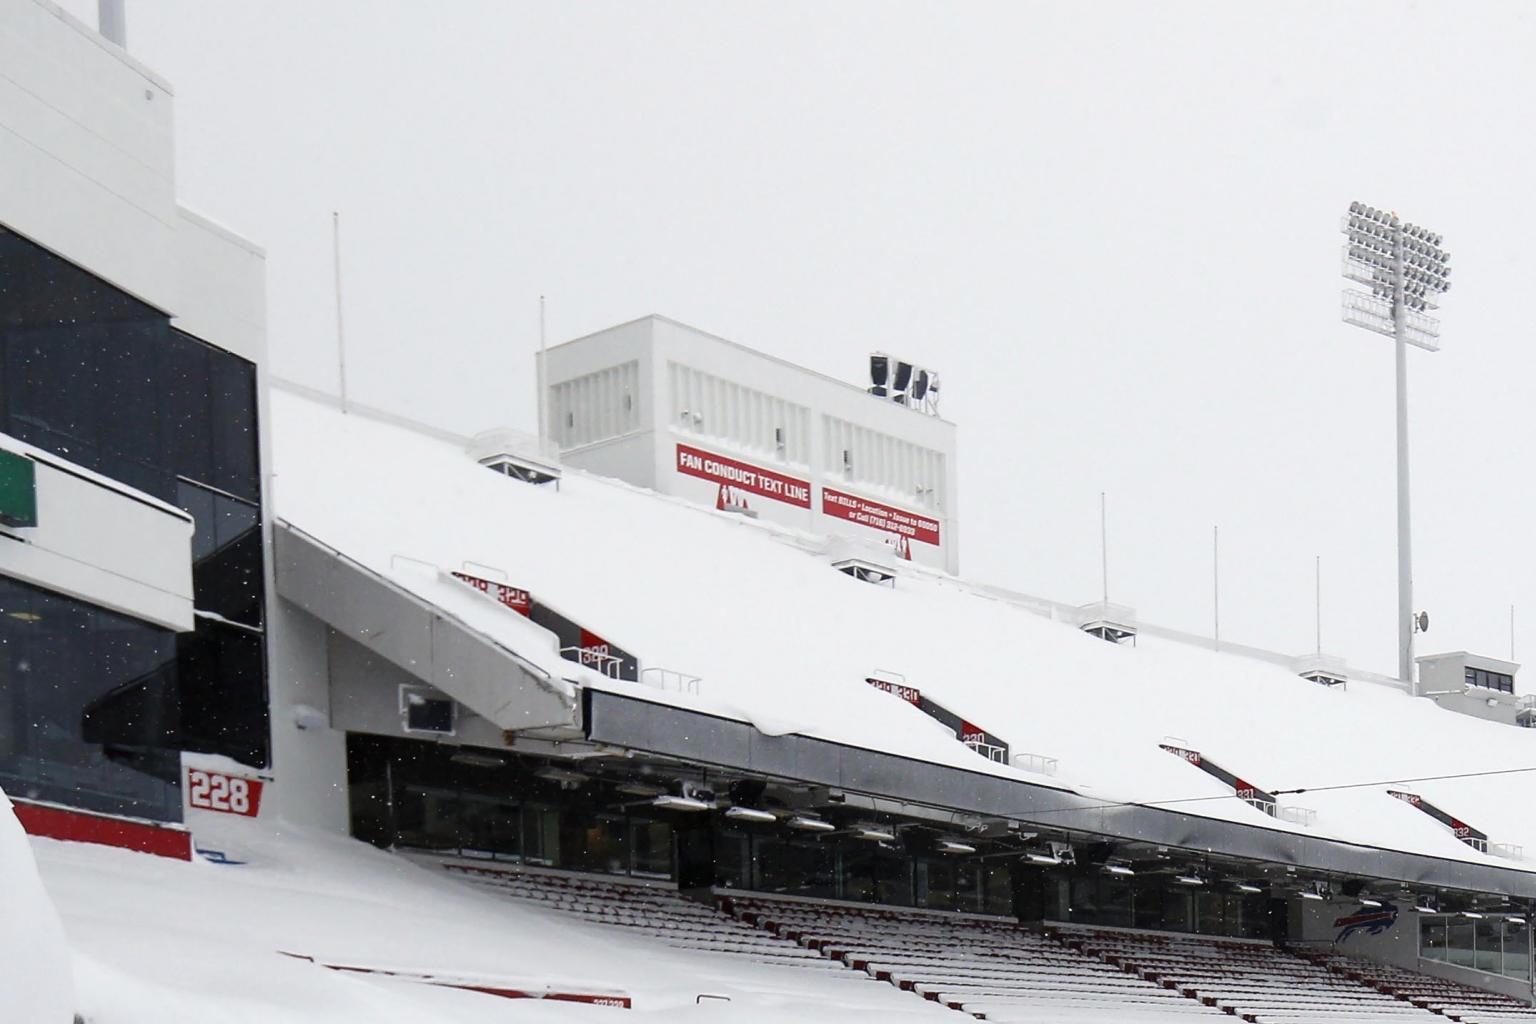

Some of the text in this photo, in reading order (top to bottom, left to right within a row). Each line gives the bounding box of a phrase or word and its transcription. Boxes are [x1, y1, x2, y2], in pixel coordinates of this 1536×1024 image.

[680, 452, 809, 501] FAN CONDUCT TEXT LINE
[823, 491, 837, 502] Text
[191, 771, 250, 813] 228
